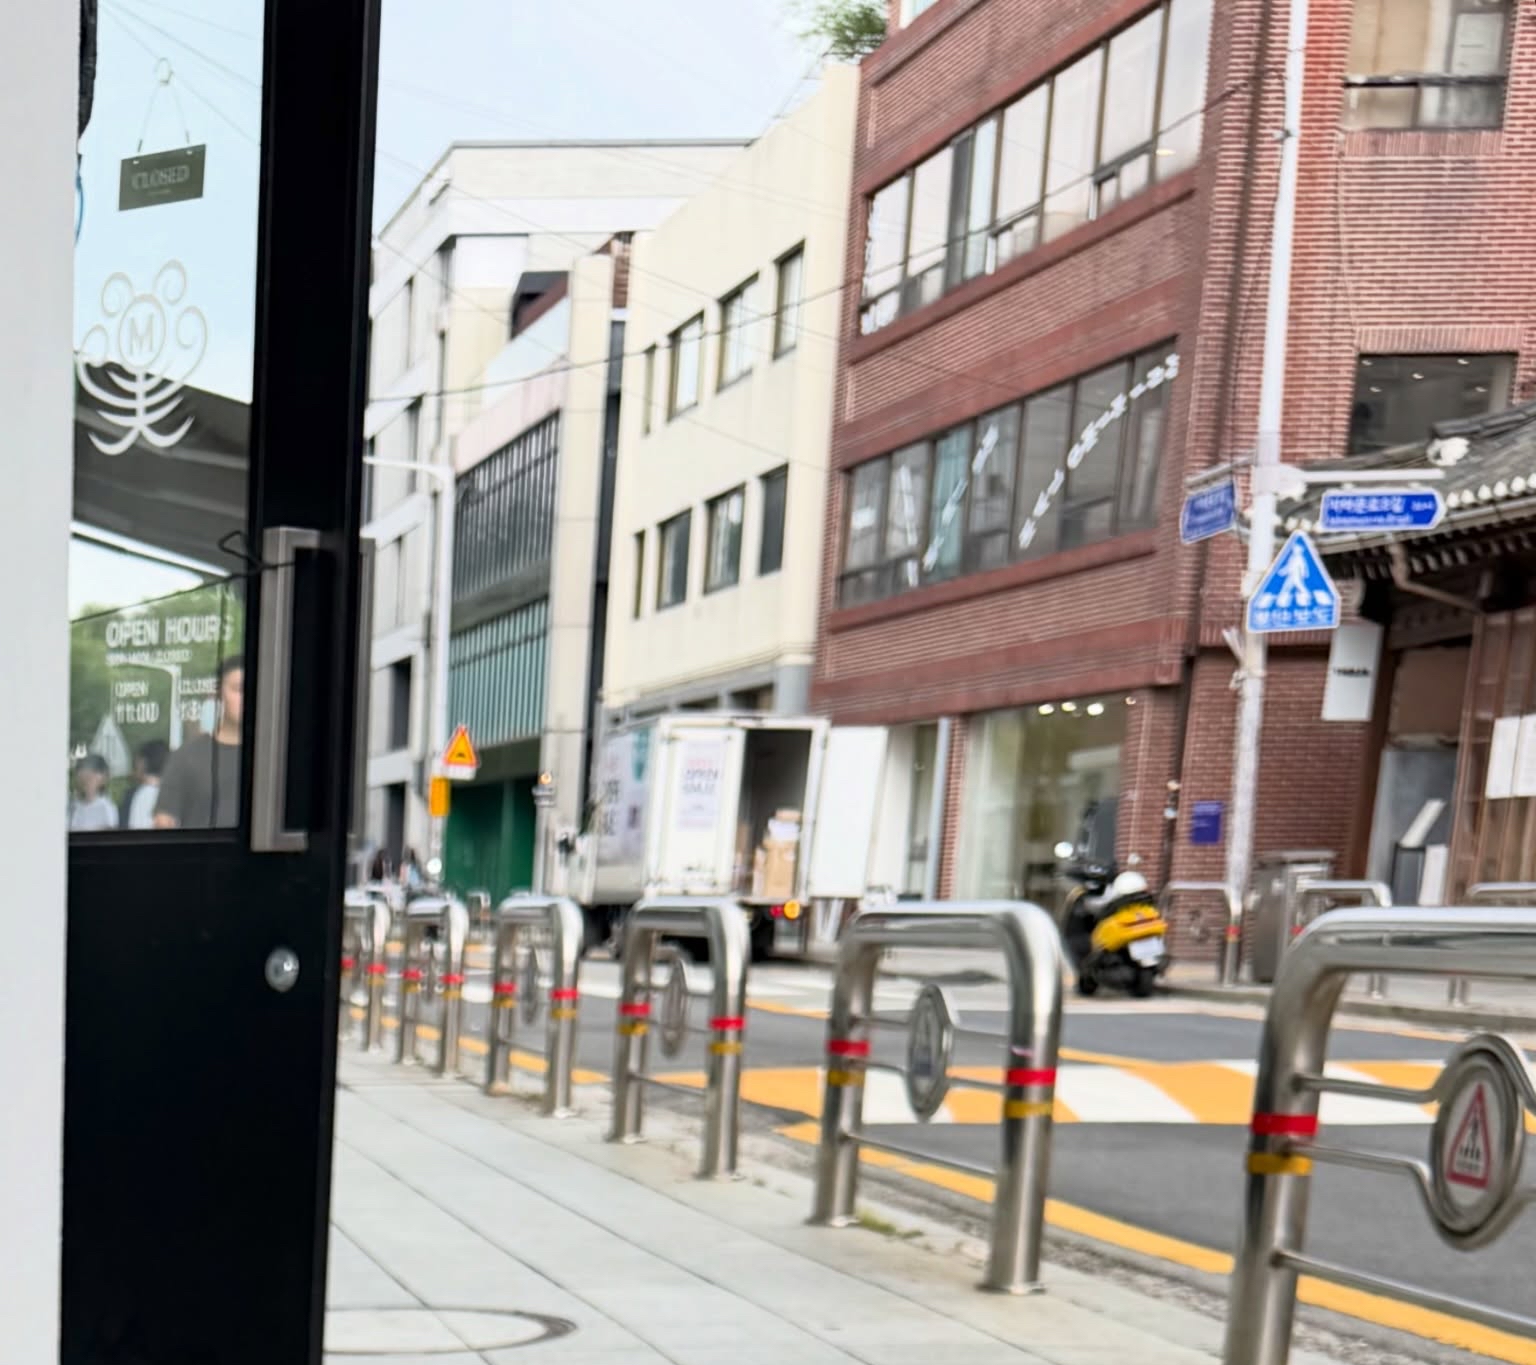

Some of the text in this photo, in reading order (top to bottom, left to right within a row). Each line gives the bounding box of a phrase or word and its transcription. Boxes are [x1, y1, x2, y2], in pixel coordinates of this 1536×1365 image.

[131, 165, 190, 190] CLOSED
[105, 614, 233, 648] OPEN HOURS
[114, 681, 149, 697] OPEN
